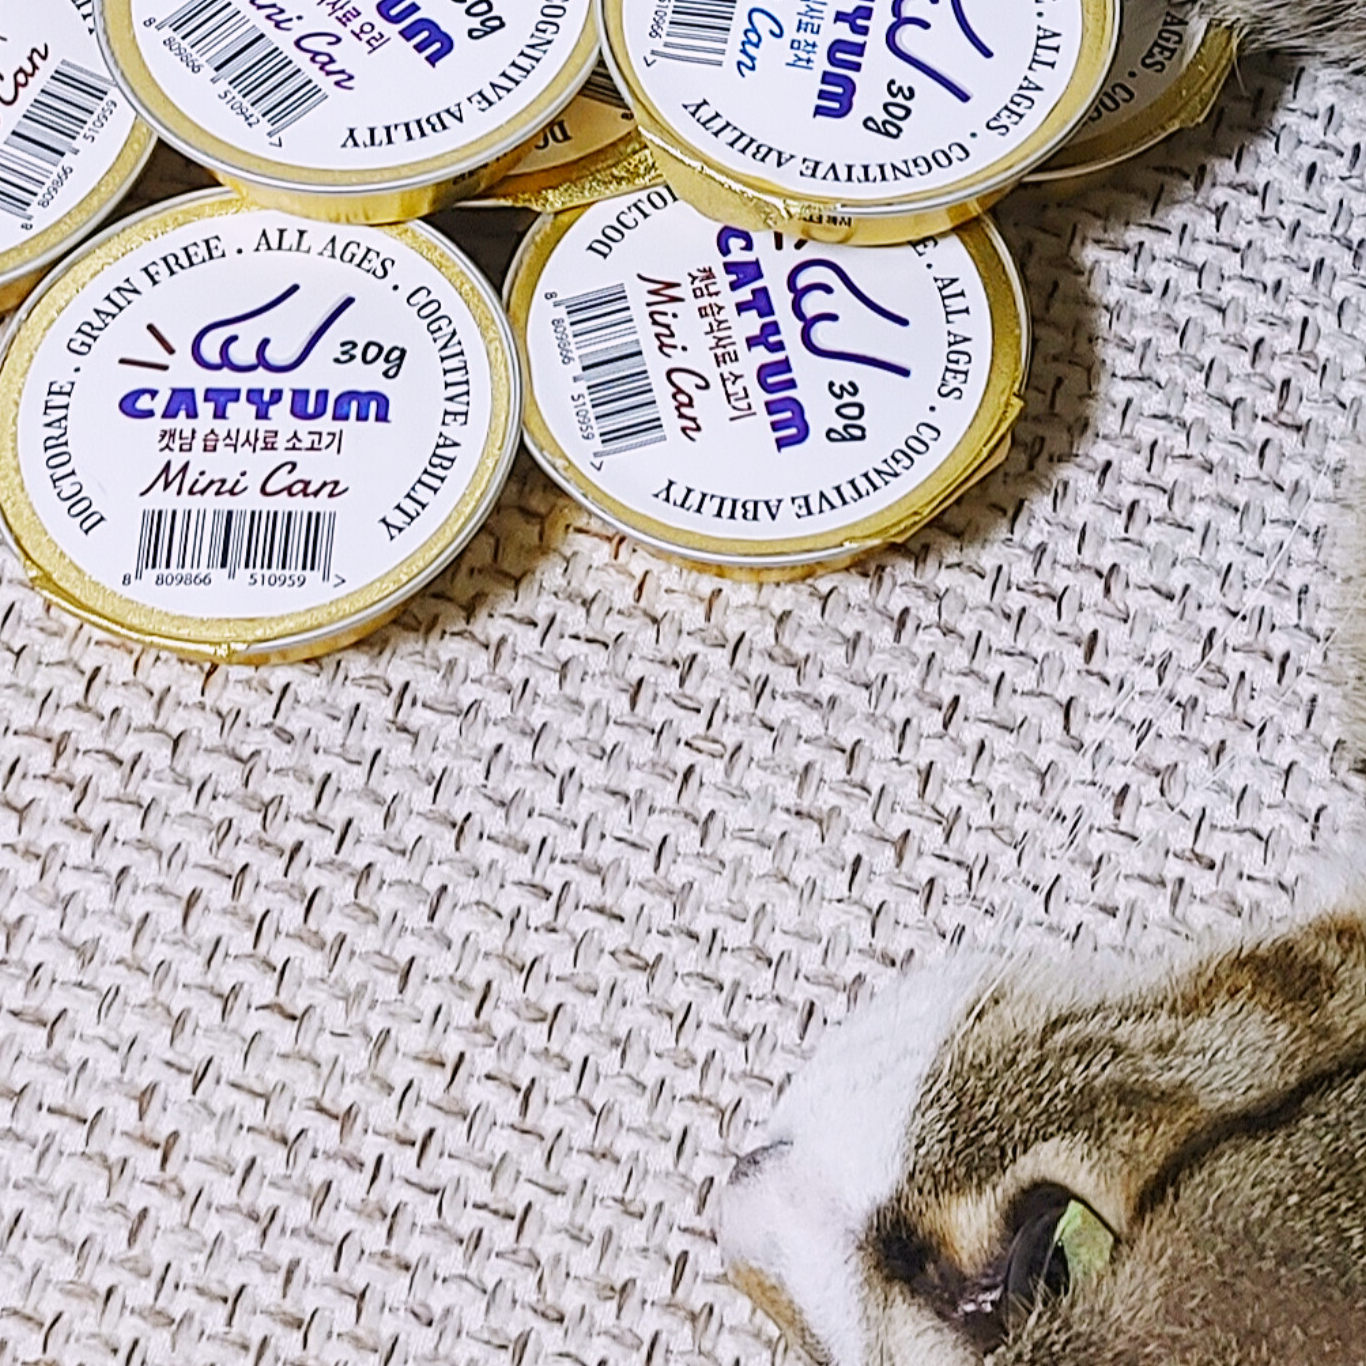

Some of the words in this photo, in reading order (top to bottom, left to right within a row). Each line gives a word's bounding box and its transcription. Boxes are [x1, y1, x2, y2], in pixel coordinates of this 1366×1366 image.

[294, 30, 355, 92] Can
[351, 22, 392, 57] 오리
[736, 4, 784, 78] Can
[784, 36, 824, 72] 참치
[1035, 22, 1063, 66] ALL
[340, 107, 465, 149] ABILITY
[861, 79, 917, 140] 30g
[986, 70, 1045, 138] AGES
[682, 98, 797, 173] ABILITY
[799, 139, 971, 185] COGNITIVE
[253, 228, 312, 255] ALL
[317, 237, 396, 281] AGES
[66, 277, 144, 357] GRAIN
[139, 235, 227, 287] FREE
[933, 274, 971, 334] ALL
[333, 339, 407, 380] 30g
[406, 285, 472, 428] COGNITIVE
[637, 273, 688, 371] Mini
[665, 367, 710, 443] Can
[696, 301, 739, 368] 습식사료
[718, 369, 758, 422] 소고기
[716, 225, 811, 452] CATYUM
[937, 335, 973, 402] AGES
[119, 388, 392, 424] CATYUM
[825, 380, 867, 445] 30g
[43, 380, 107, 537] DOCTORATE
[201, 429, 279, 454] 습식사료
[284, 430, 343, 455] 소고기
[790, 422, 941, 519] COGNITIVE
[139, 460, 249, 500] Mini
[259, 462, 350, 501] Can
[383, 430, 463, 542] ABILITY
[652, 478, 784, 522] ABILITY
[122, 574, 132, 586] 8
[155, 573, 212, 587] 809866
[247, 574, 308, 589] 510959
